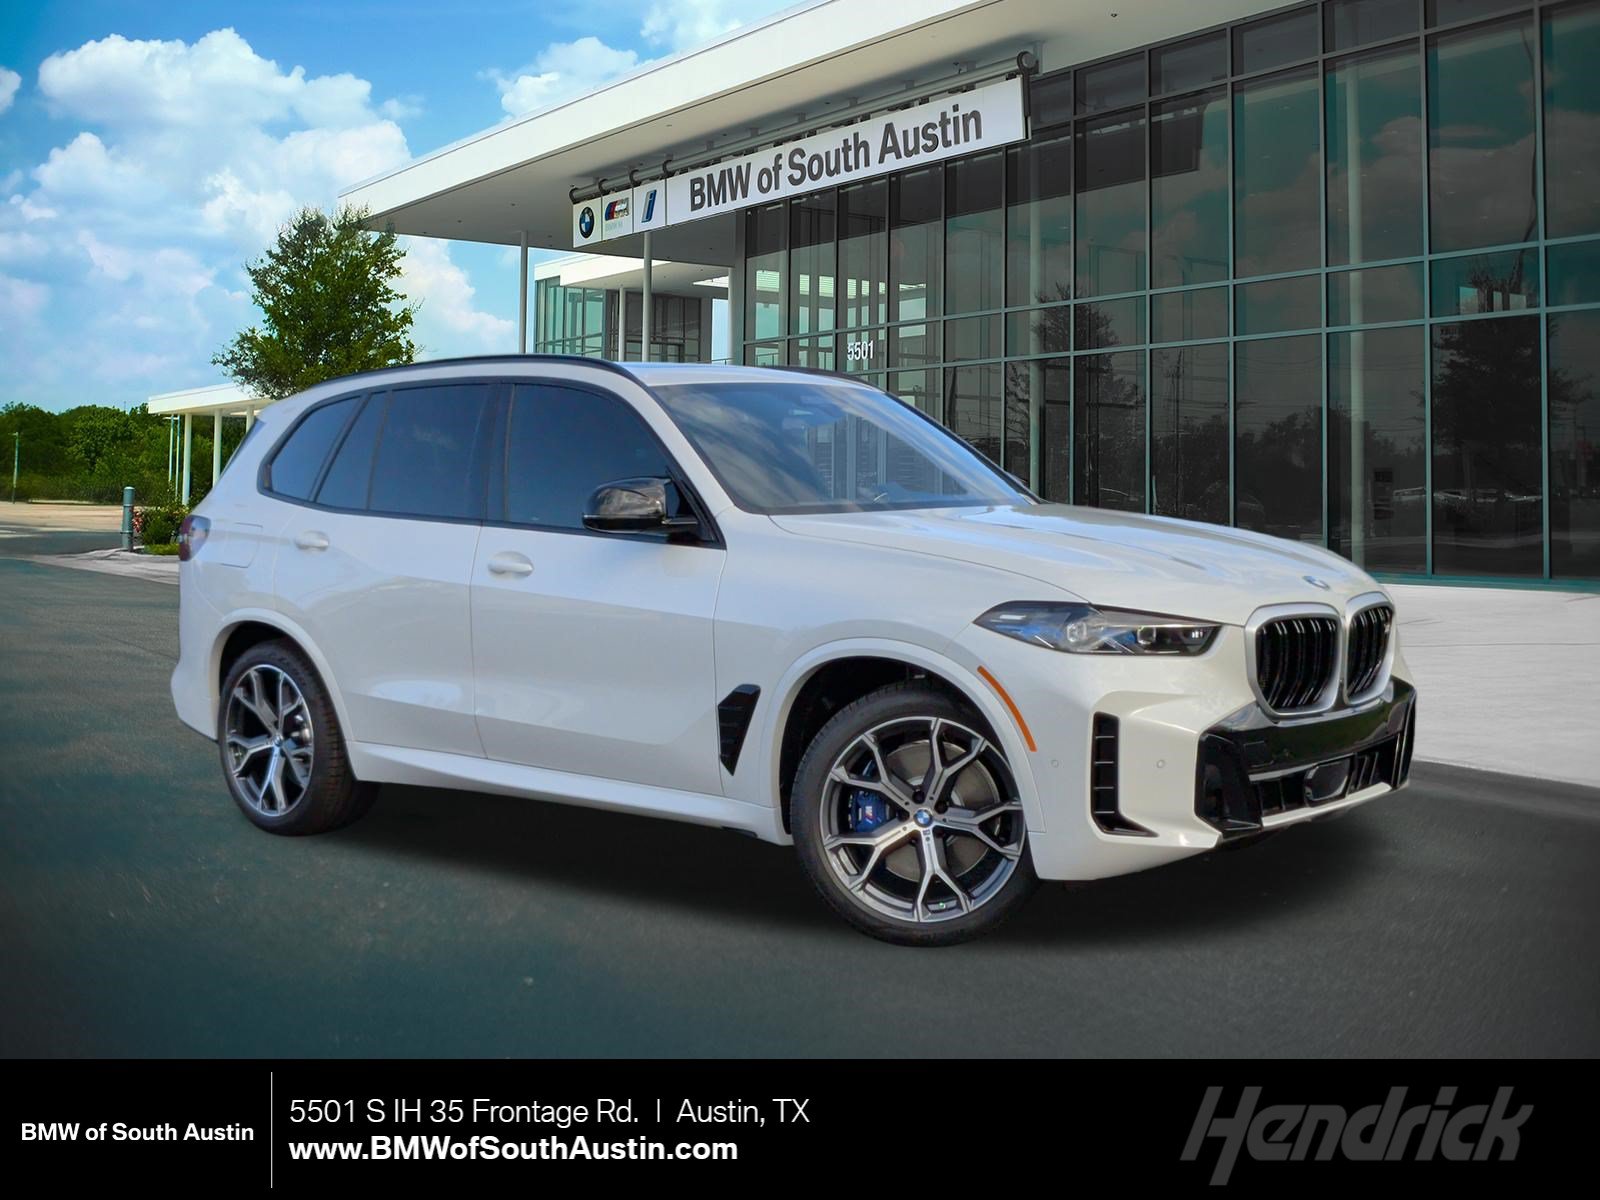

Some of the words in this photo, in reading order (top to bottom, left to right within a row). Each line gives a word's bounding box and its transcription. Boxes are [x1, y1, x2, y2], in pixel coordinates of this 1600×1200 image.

[691, 162, 751, 211] BMW
[757, 153, 782, 194] of
[787, 132, 870, 186] South
[879, 105, 982, 163] Austin
[847, 340, 873, 360] 5501
